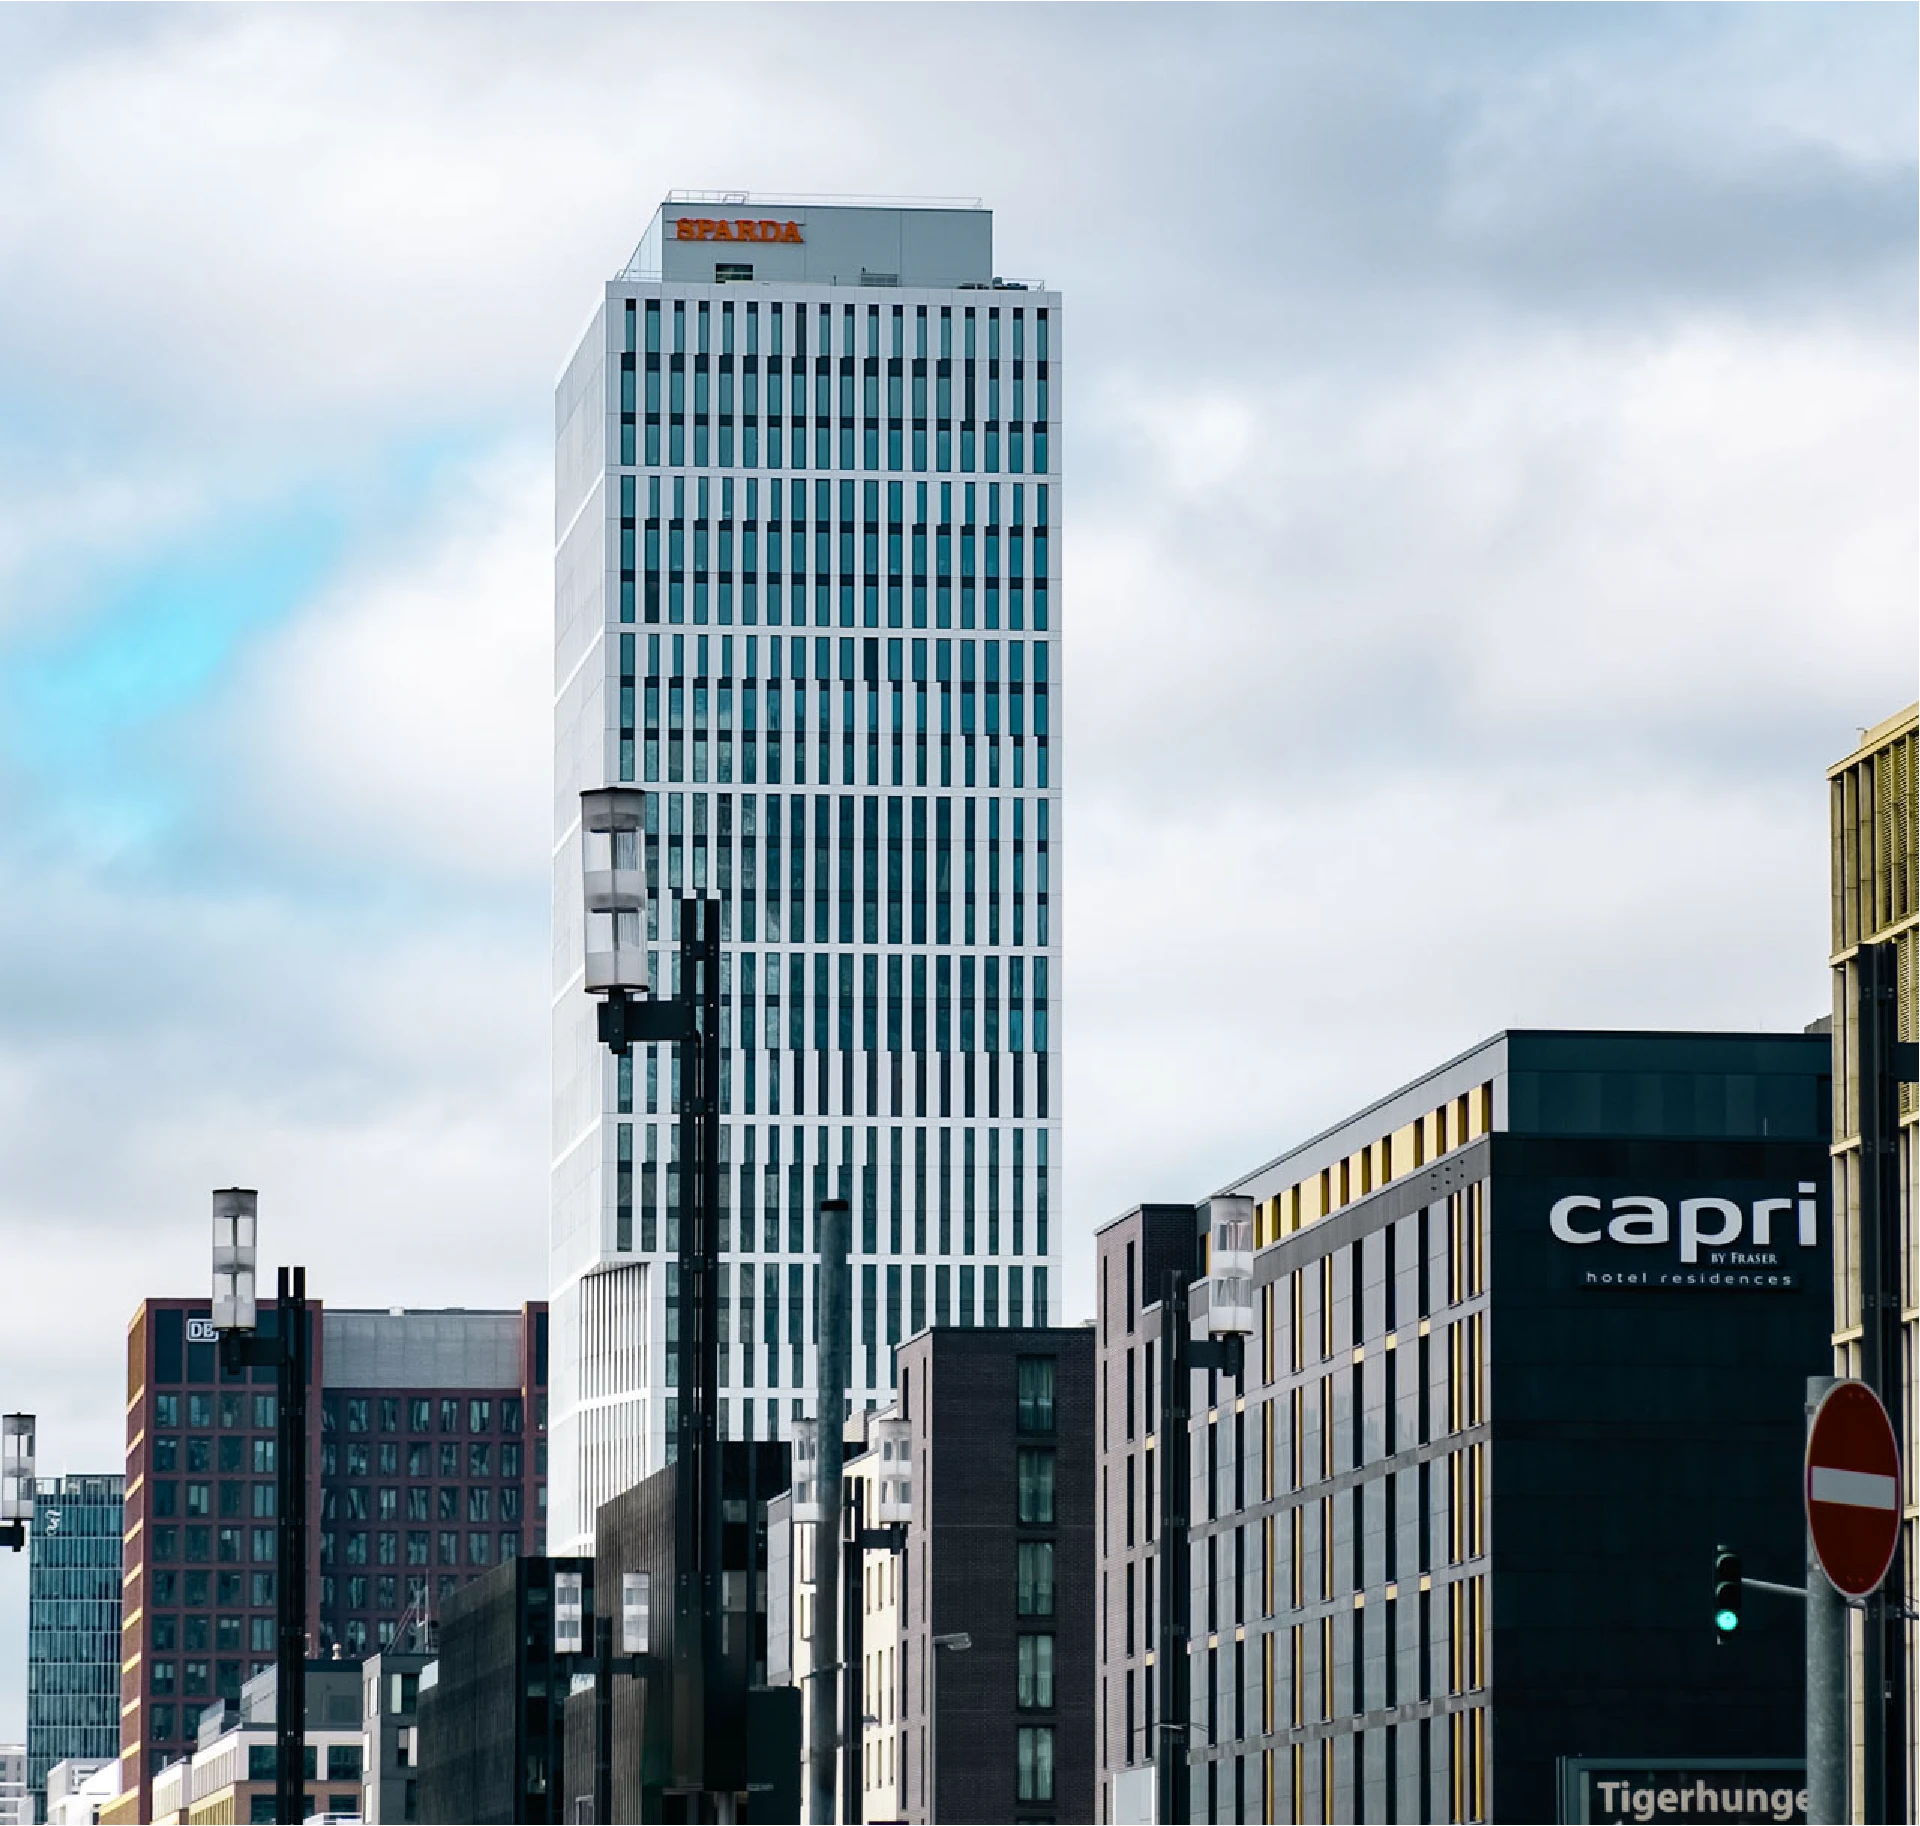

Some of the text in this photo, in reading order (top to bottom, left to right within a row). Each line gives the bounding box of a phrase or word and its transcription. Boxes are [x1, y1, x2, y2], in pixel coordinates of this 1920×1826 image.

[676, 218, 804, 243] SPARDA
[1549, 1181, 1817, 1263] capri
[1711, 1252, 1778, 1264] BY FRASER
[1585, 1271, 1793, 1286] hotel residences
[191, 1323, 215, 1338] DB
